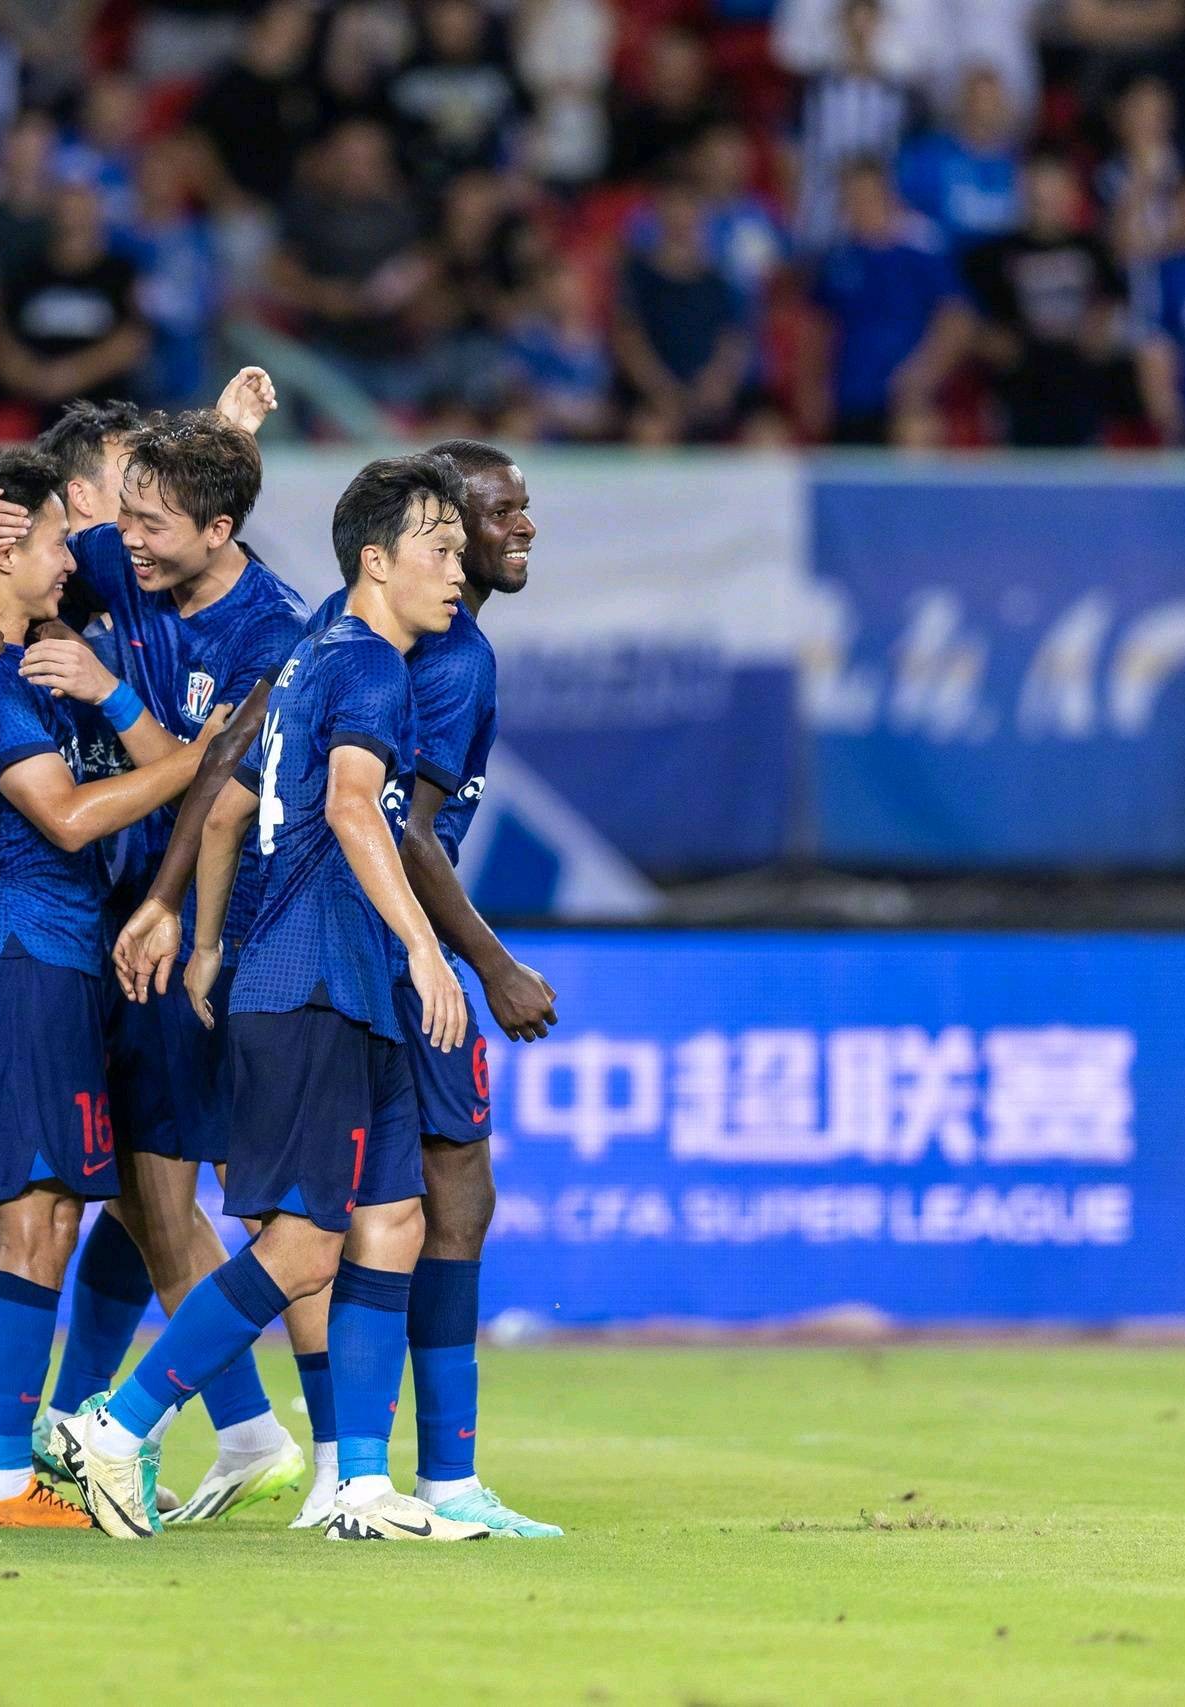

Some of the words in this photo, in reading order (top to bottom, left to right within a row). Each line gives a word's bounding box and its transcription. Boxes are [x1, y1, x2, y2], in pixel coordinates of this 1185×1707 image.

[472, 1035, 490, 1098] 6
[490, 1028, 1134, 1163] 中超联赛
[75, 1091, 114, 1154] 16
[682, 1186, 884, 1243] SUPER
[890, 1185, 1132, 1243] LEAGUE
